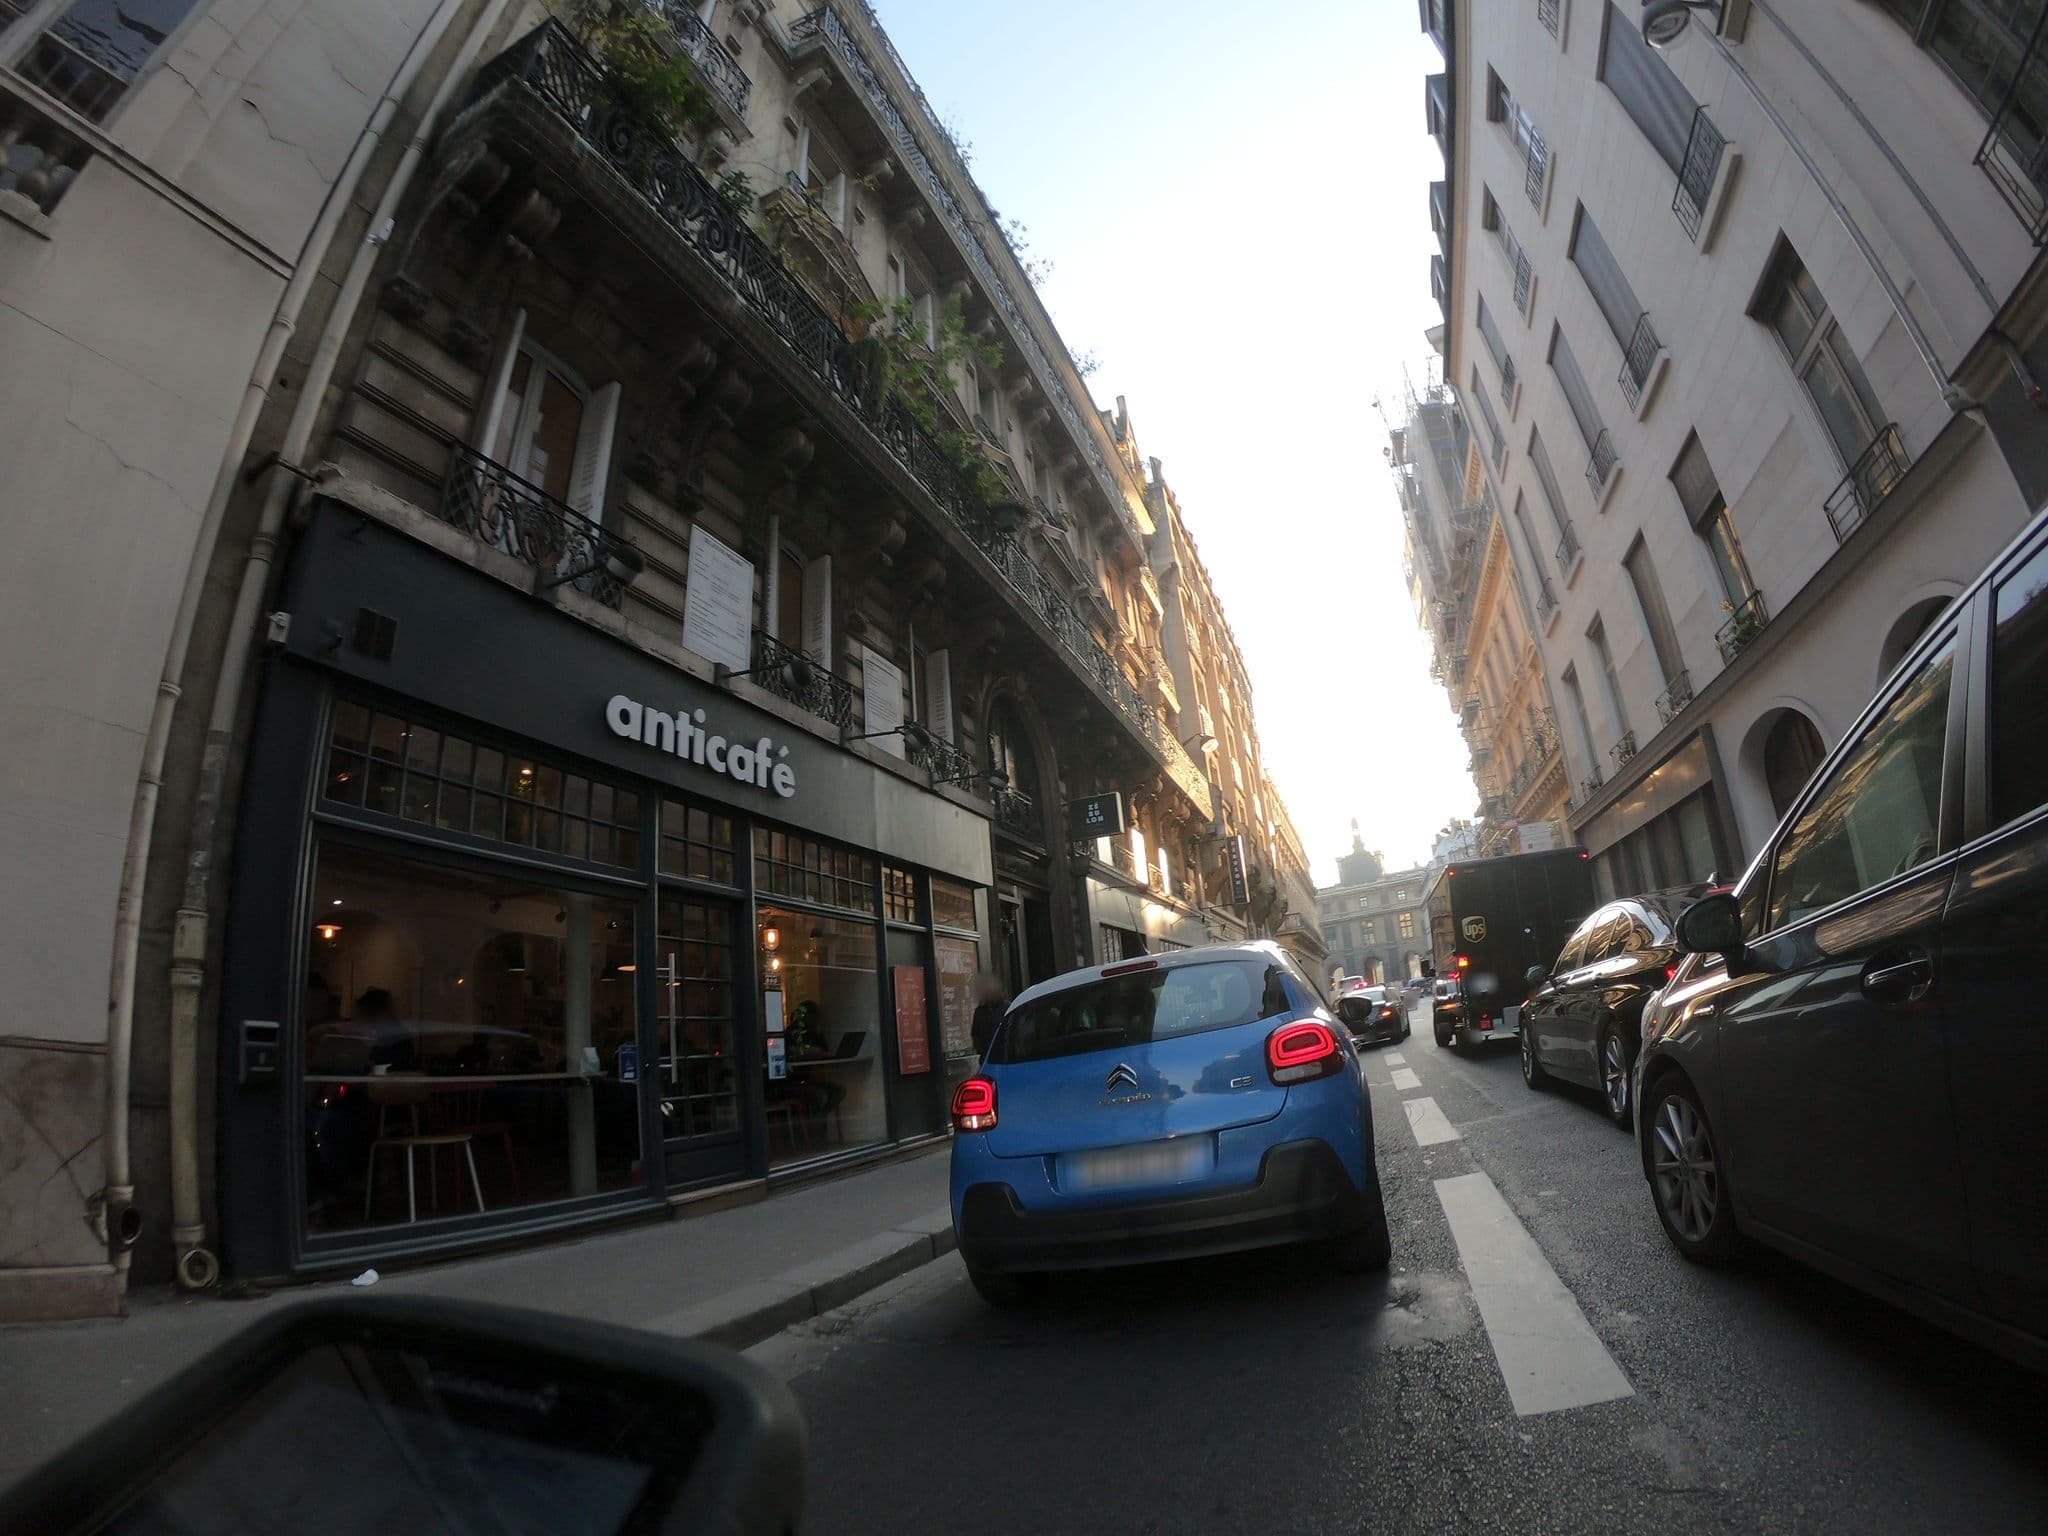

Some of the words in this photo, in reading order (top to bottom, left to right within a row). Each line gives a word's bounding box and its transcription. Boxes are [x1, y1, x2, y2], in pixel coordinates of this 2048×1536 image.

[605, 693, 797, 799] anticafé
[1465, 923, 1484, 939] ups
[1230, 1075, 1254, 1088] C3
